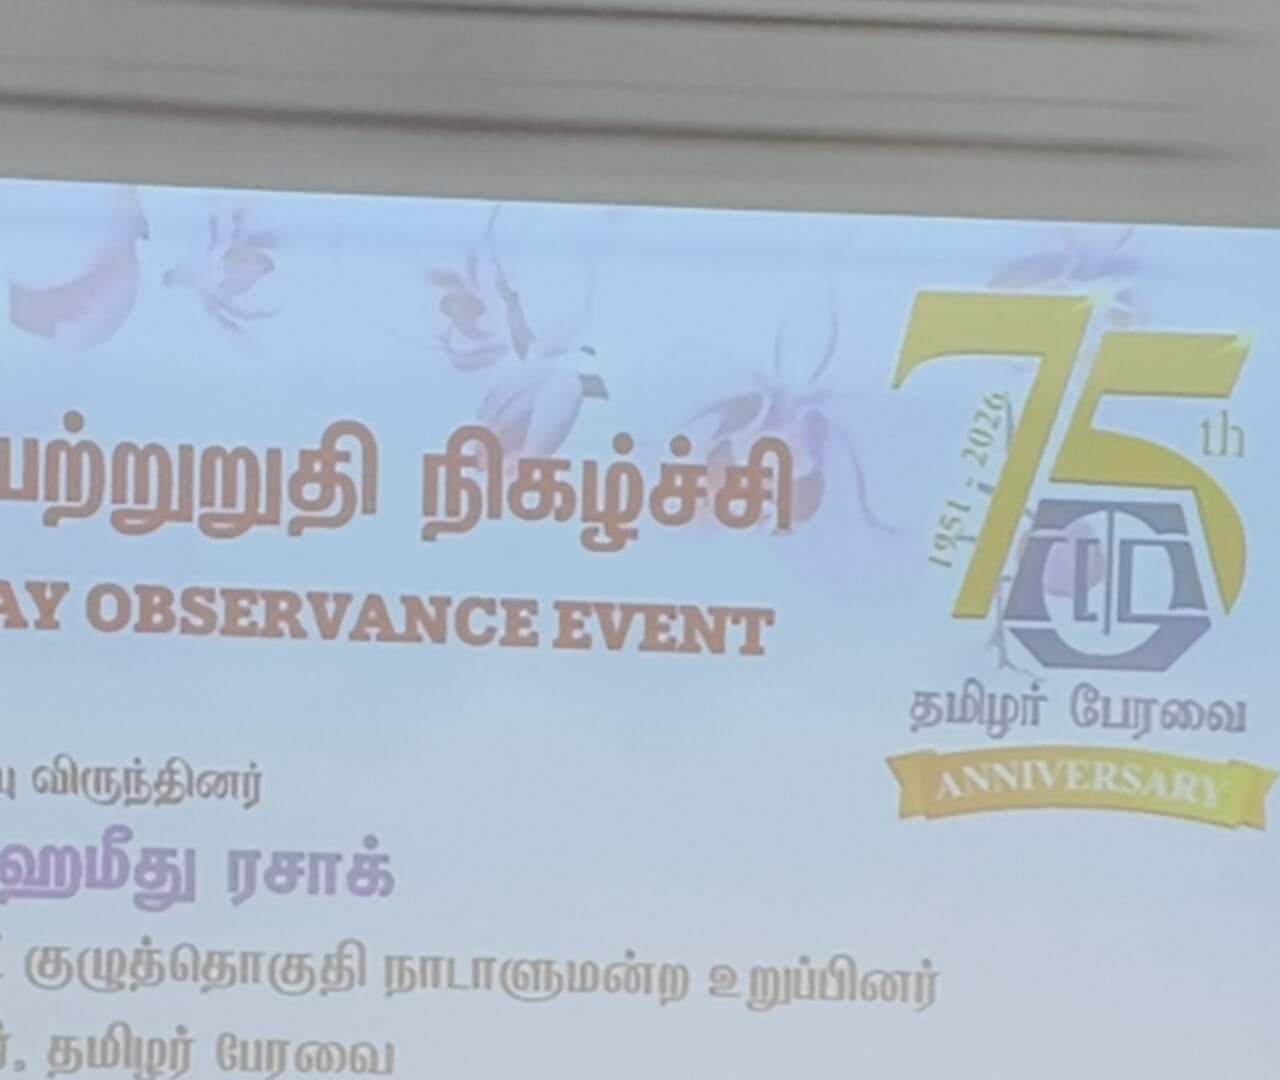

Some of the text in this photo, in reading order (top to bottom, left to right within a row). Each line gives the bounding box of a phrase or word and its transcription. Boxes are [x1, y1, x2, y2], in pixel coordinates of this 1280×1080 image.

[421, 425, 794, 553] நிகழ்ச்சி
[85, 583, 539, 648] OBSERVANCE
[552, 600, 775, 656] EVENT
[909, 676, 1247, 743] தமிழர் பேரவை
[31, 753, 263, 810] விருந்தினர்
[934, 758, 1234, 812] ANNIVERSARY
[227, 834, 395, 907] ரசாக்
[24, 935, 367, 997] குழுத்தொகுதி
[383, 948, 690, 1007] நாடாளுமன்ற
[708, 953, 939, 1013] உறுப்பினர்
